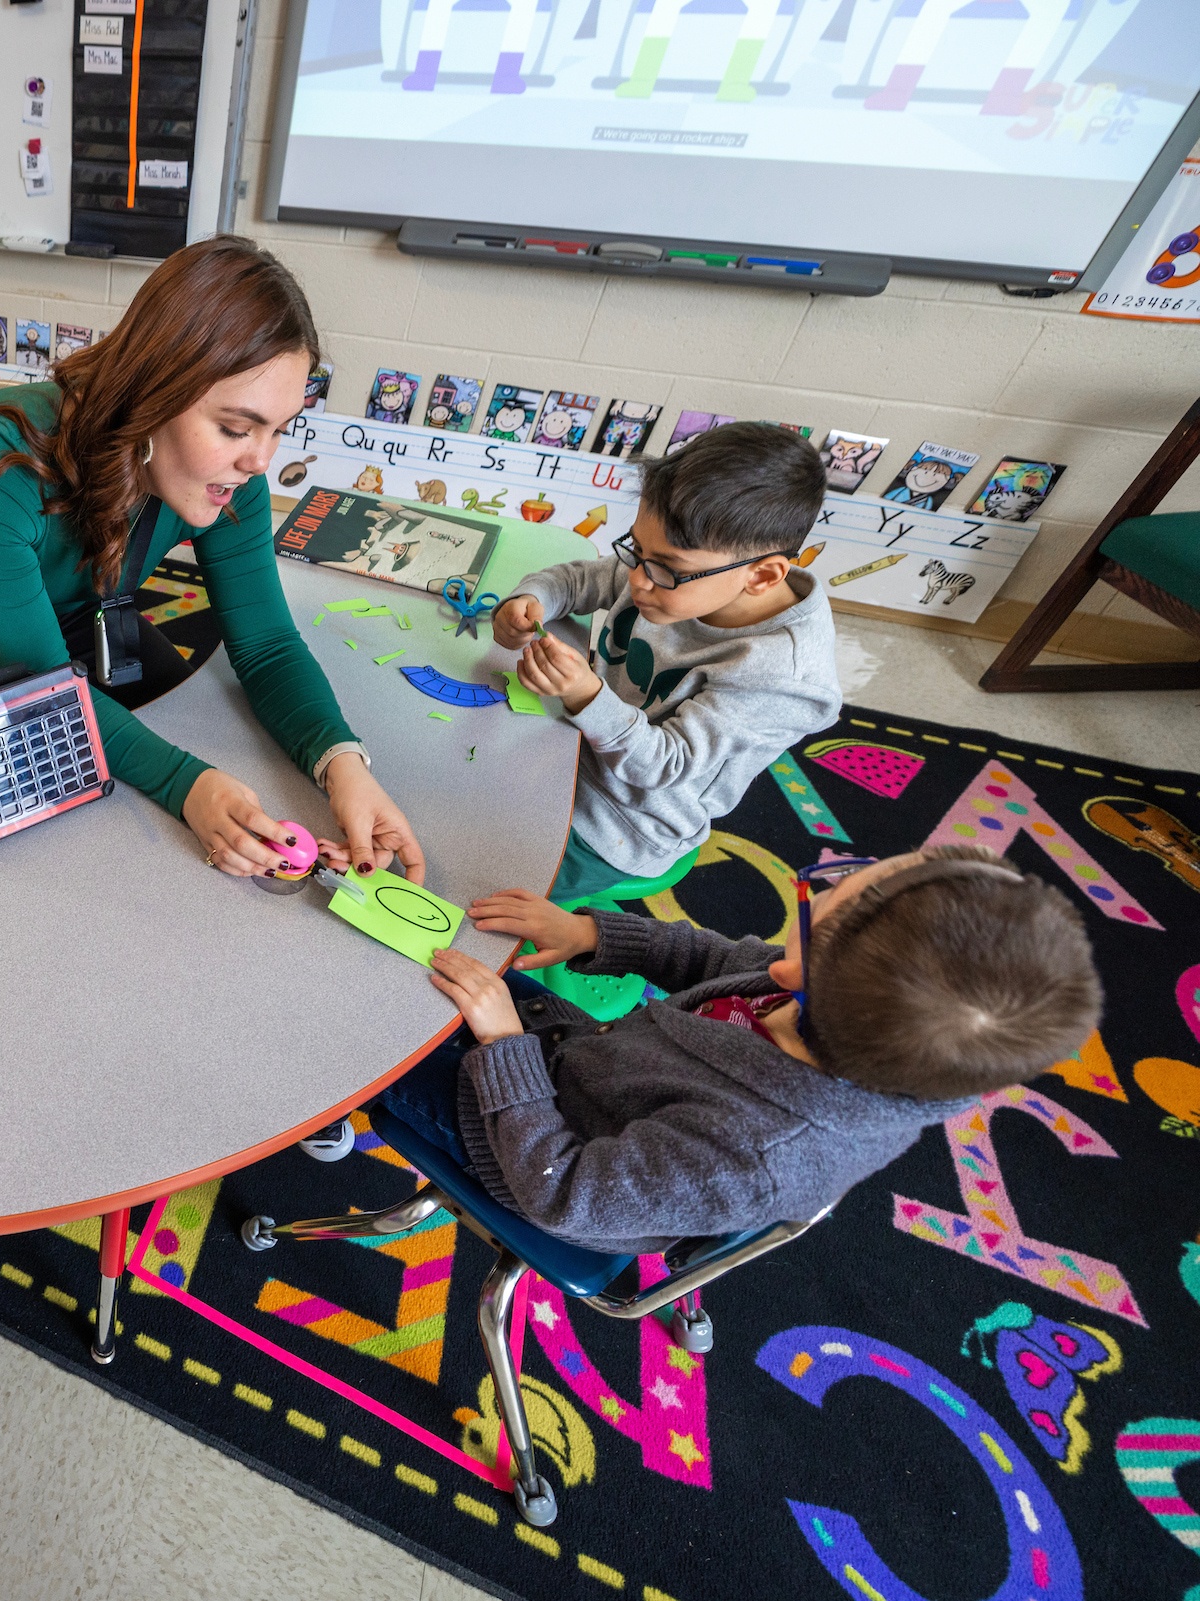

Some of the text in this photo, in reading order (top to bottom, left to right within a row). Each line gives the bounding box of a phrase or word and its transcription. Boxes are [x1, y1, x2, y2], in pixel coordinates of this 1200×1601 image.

[603, 129, 629, 139] We're
[630, 132, 658, 143] going
[658, 133, 671, 142] on
[681, 133, 712, 144] rocket
[714, 135, 736, 146] ship
[293, 417, 316, 450] Pp
[341, 425, 376, 450] Qu
[382, 439, 408, 466] qu
[427, 438, 453, 463] Rr
[480, 446, 506, 472] Ss
[535, 453, 562, 479] Tt
[591, 462, 624, 491] Uu
[877, 506, 915, 548] Yy
[949, 520, 990, 551] Zz
[279, 490, 340, 550] LIFE ON MARS
[846, 562, 875, 579] YELLOW
